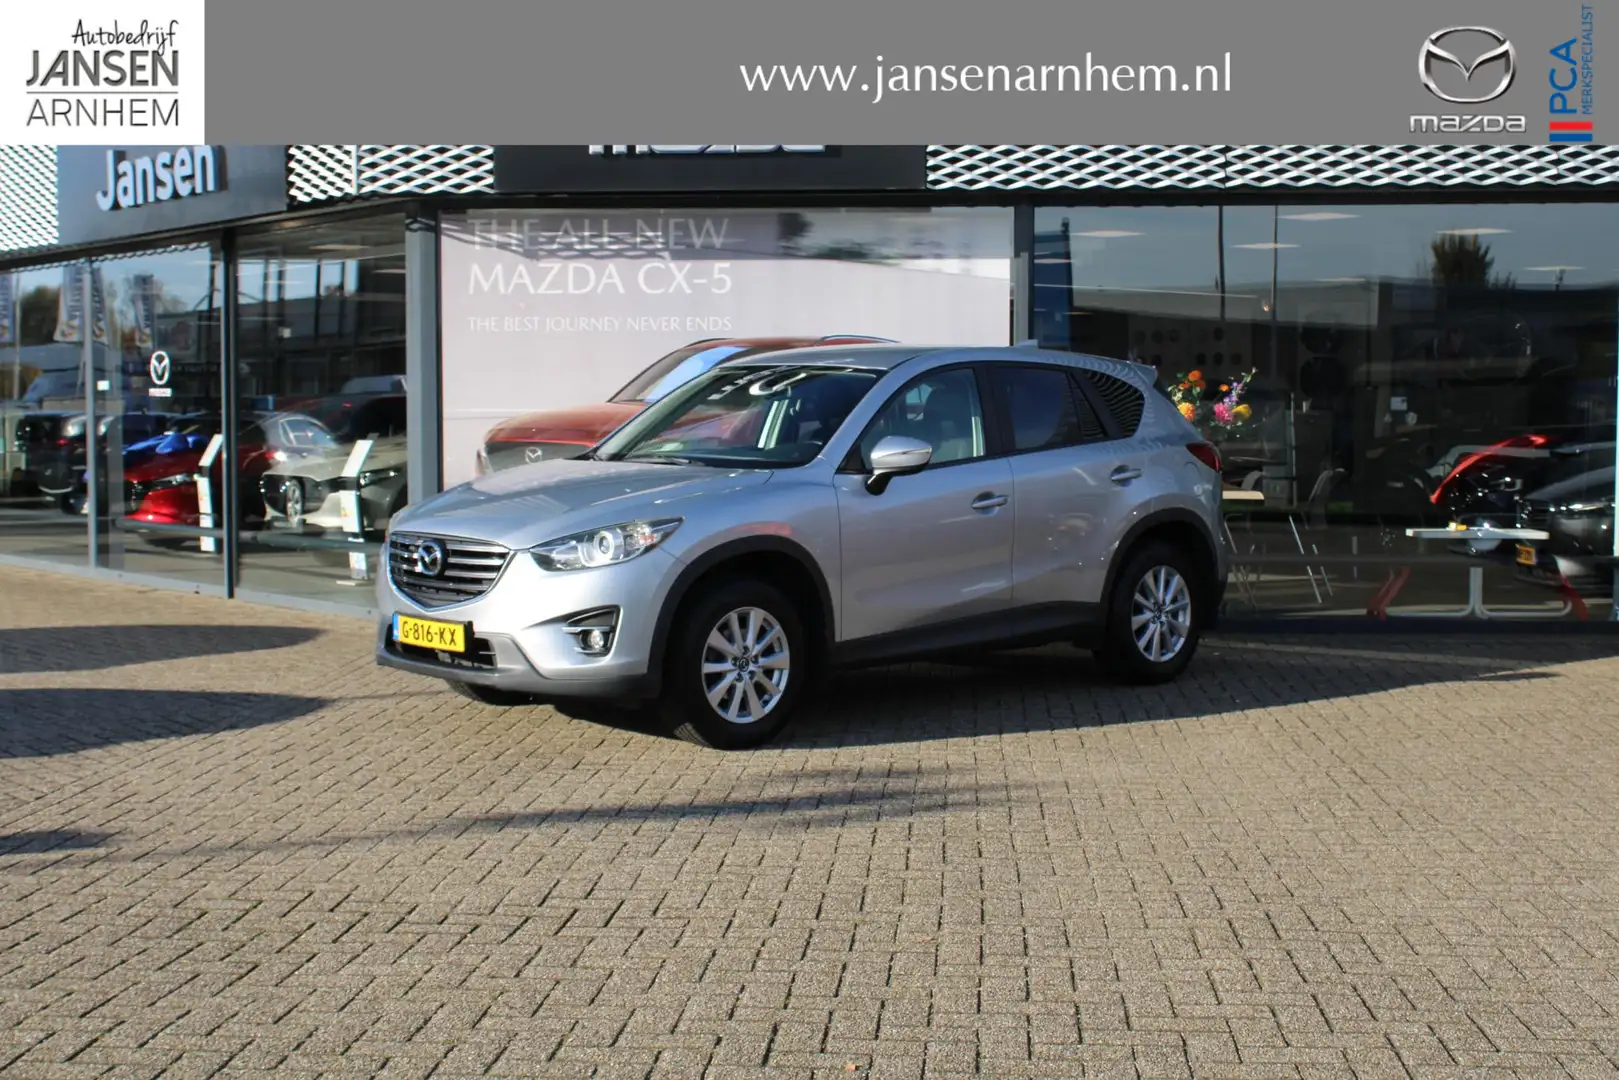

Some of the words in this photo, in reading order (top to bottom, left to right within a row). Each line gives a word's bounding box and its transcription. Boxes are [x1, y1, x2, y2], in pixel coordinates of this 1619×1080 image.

[95, 145, 216, 212] Jansen
[467, 218, 540, 249] THE
[557, 218, 625, 249] ALL
[636, 218, 729, 249] NEW
[468, 262, 625, 295] MAZDA
[637, 262, 732, 295] CX-5
[467, 316, 498, 331] THE
[504, 316, 540, 331] BEST
[545, 316, 620, 332] JOURNEY
[627, 316, 681, 331] NEVER
[686, 316, 732, 331] ENDS
[402, 620, 457, 647] G-816-KX
